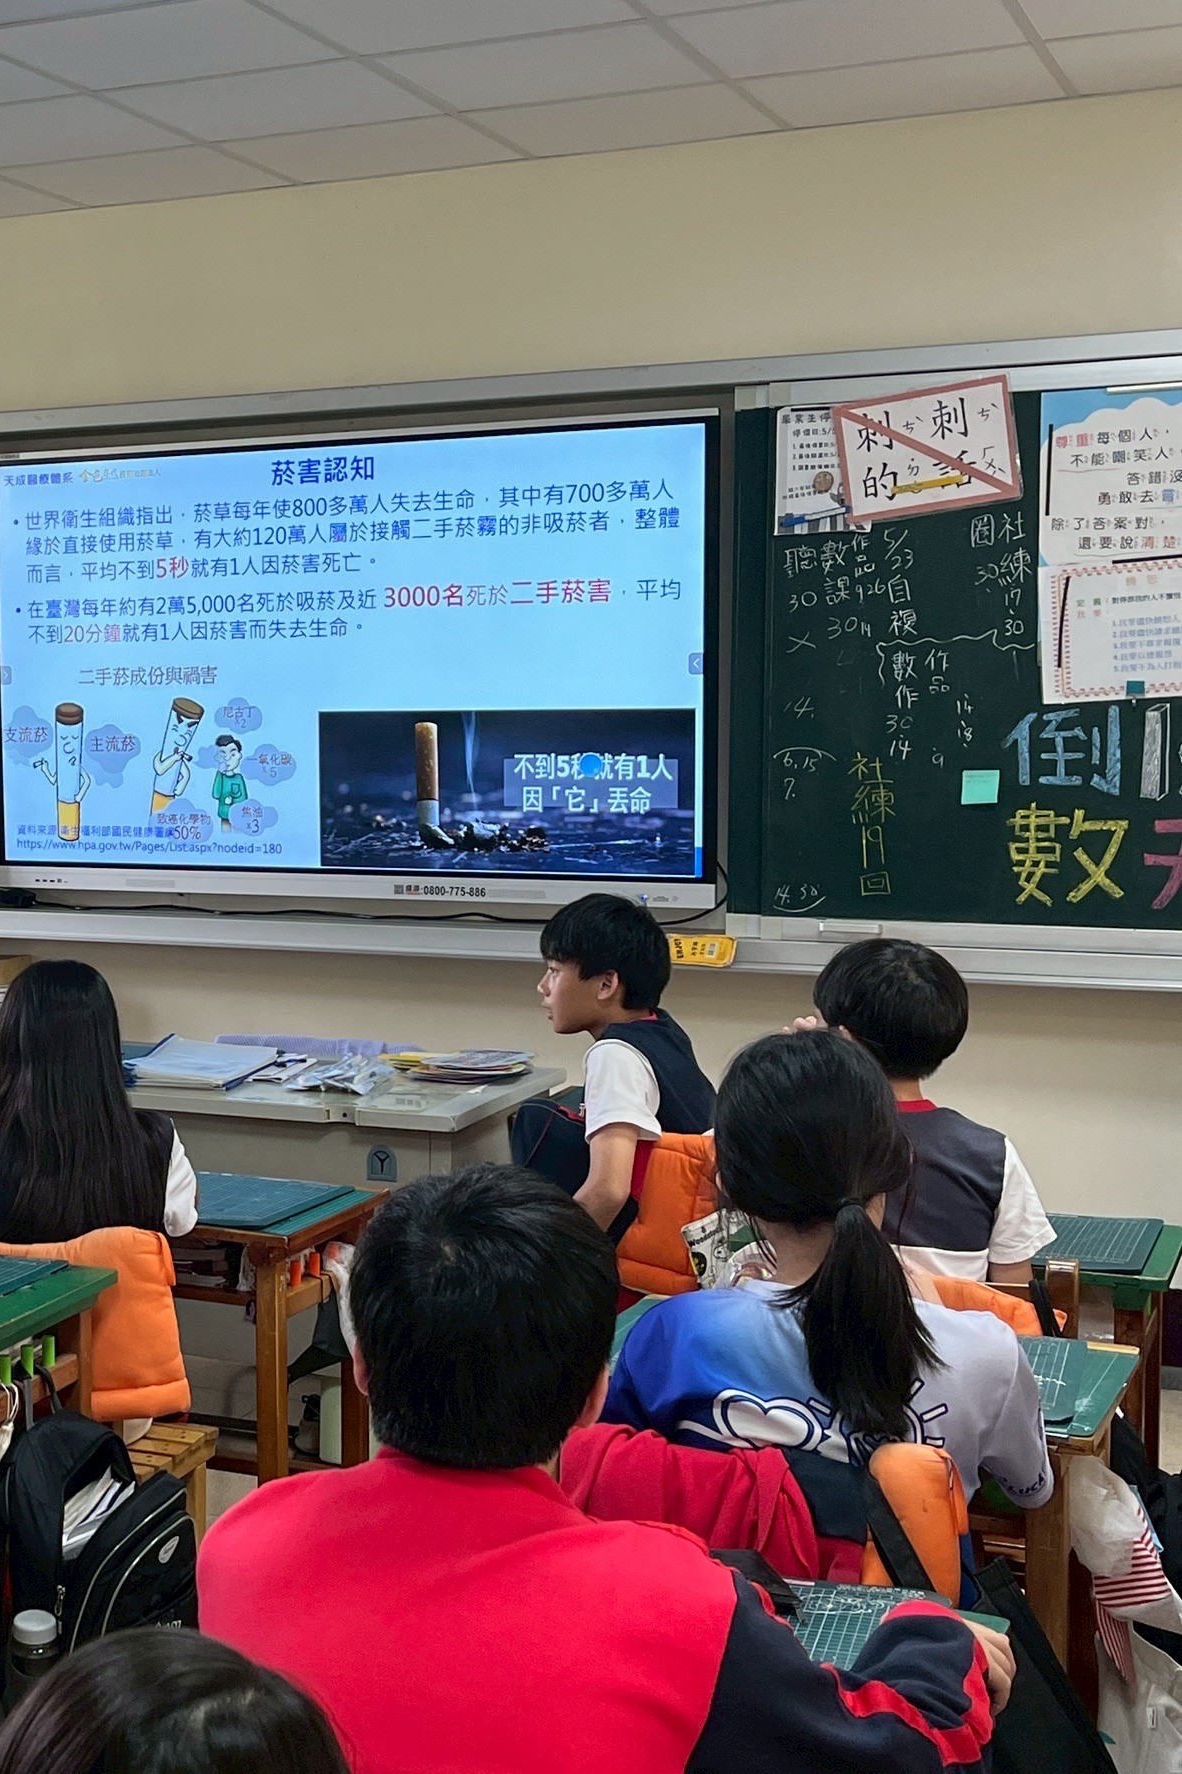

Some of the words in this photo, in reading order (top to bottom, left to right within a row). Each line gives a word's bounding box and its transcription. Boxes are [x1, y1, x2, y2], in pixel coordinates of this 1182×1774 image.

[272, 456, 374, 486] 菸害認知
[4, 727, 49, 744] 支流菸
[90, 736, 137, 753] 主流菸
[423, 885, 486, 897] 0800-775-886
